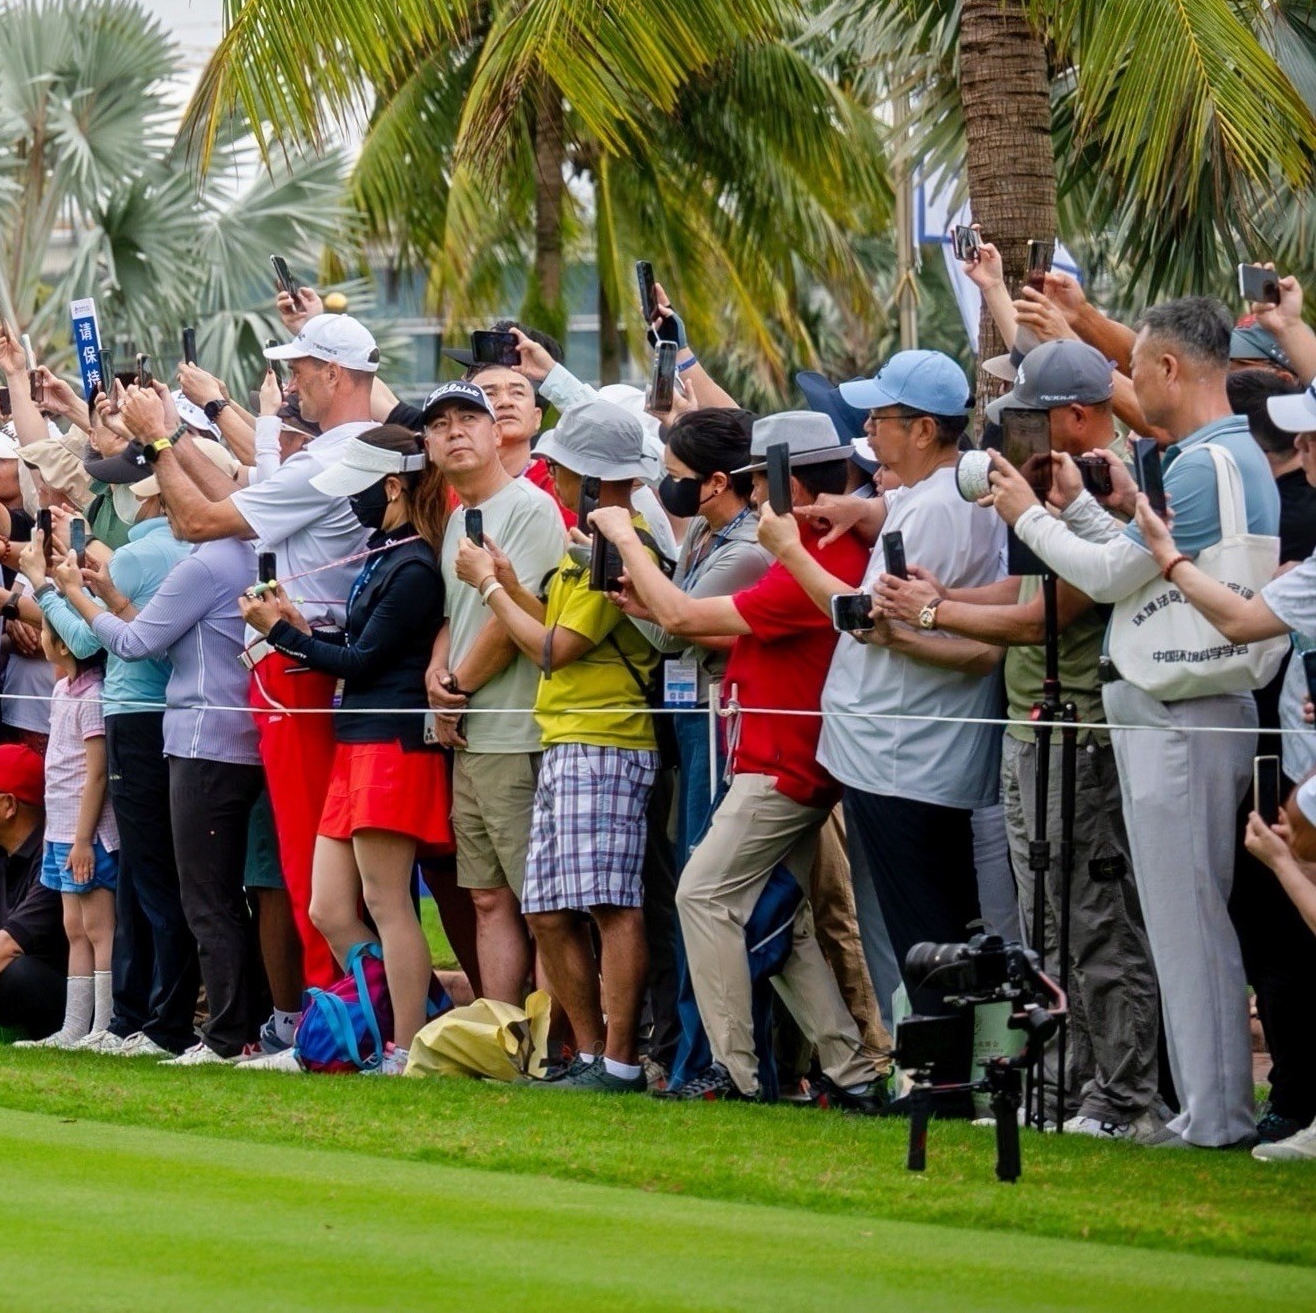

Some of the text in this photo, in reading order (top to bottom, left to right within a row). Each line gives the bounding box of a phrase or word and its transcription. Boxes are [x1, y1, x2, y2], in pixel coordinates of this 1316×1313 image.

[78, 322, 102, 388] 请保持
[427, 383, 480, 406] Titleist
[1153, 643, 1249, 663] 中国环境科学学会
